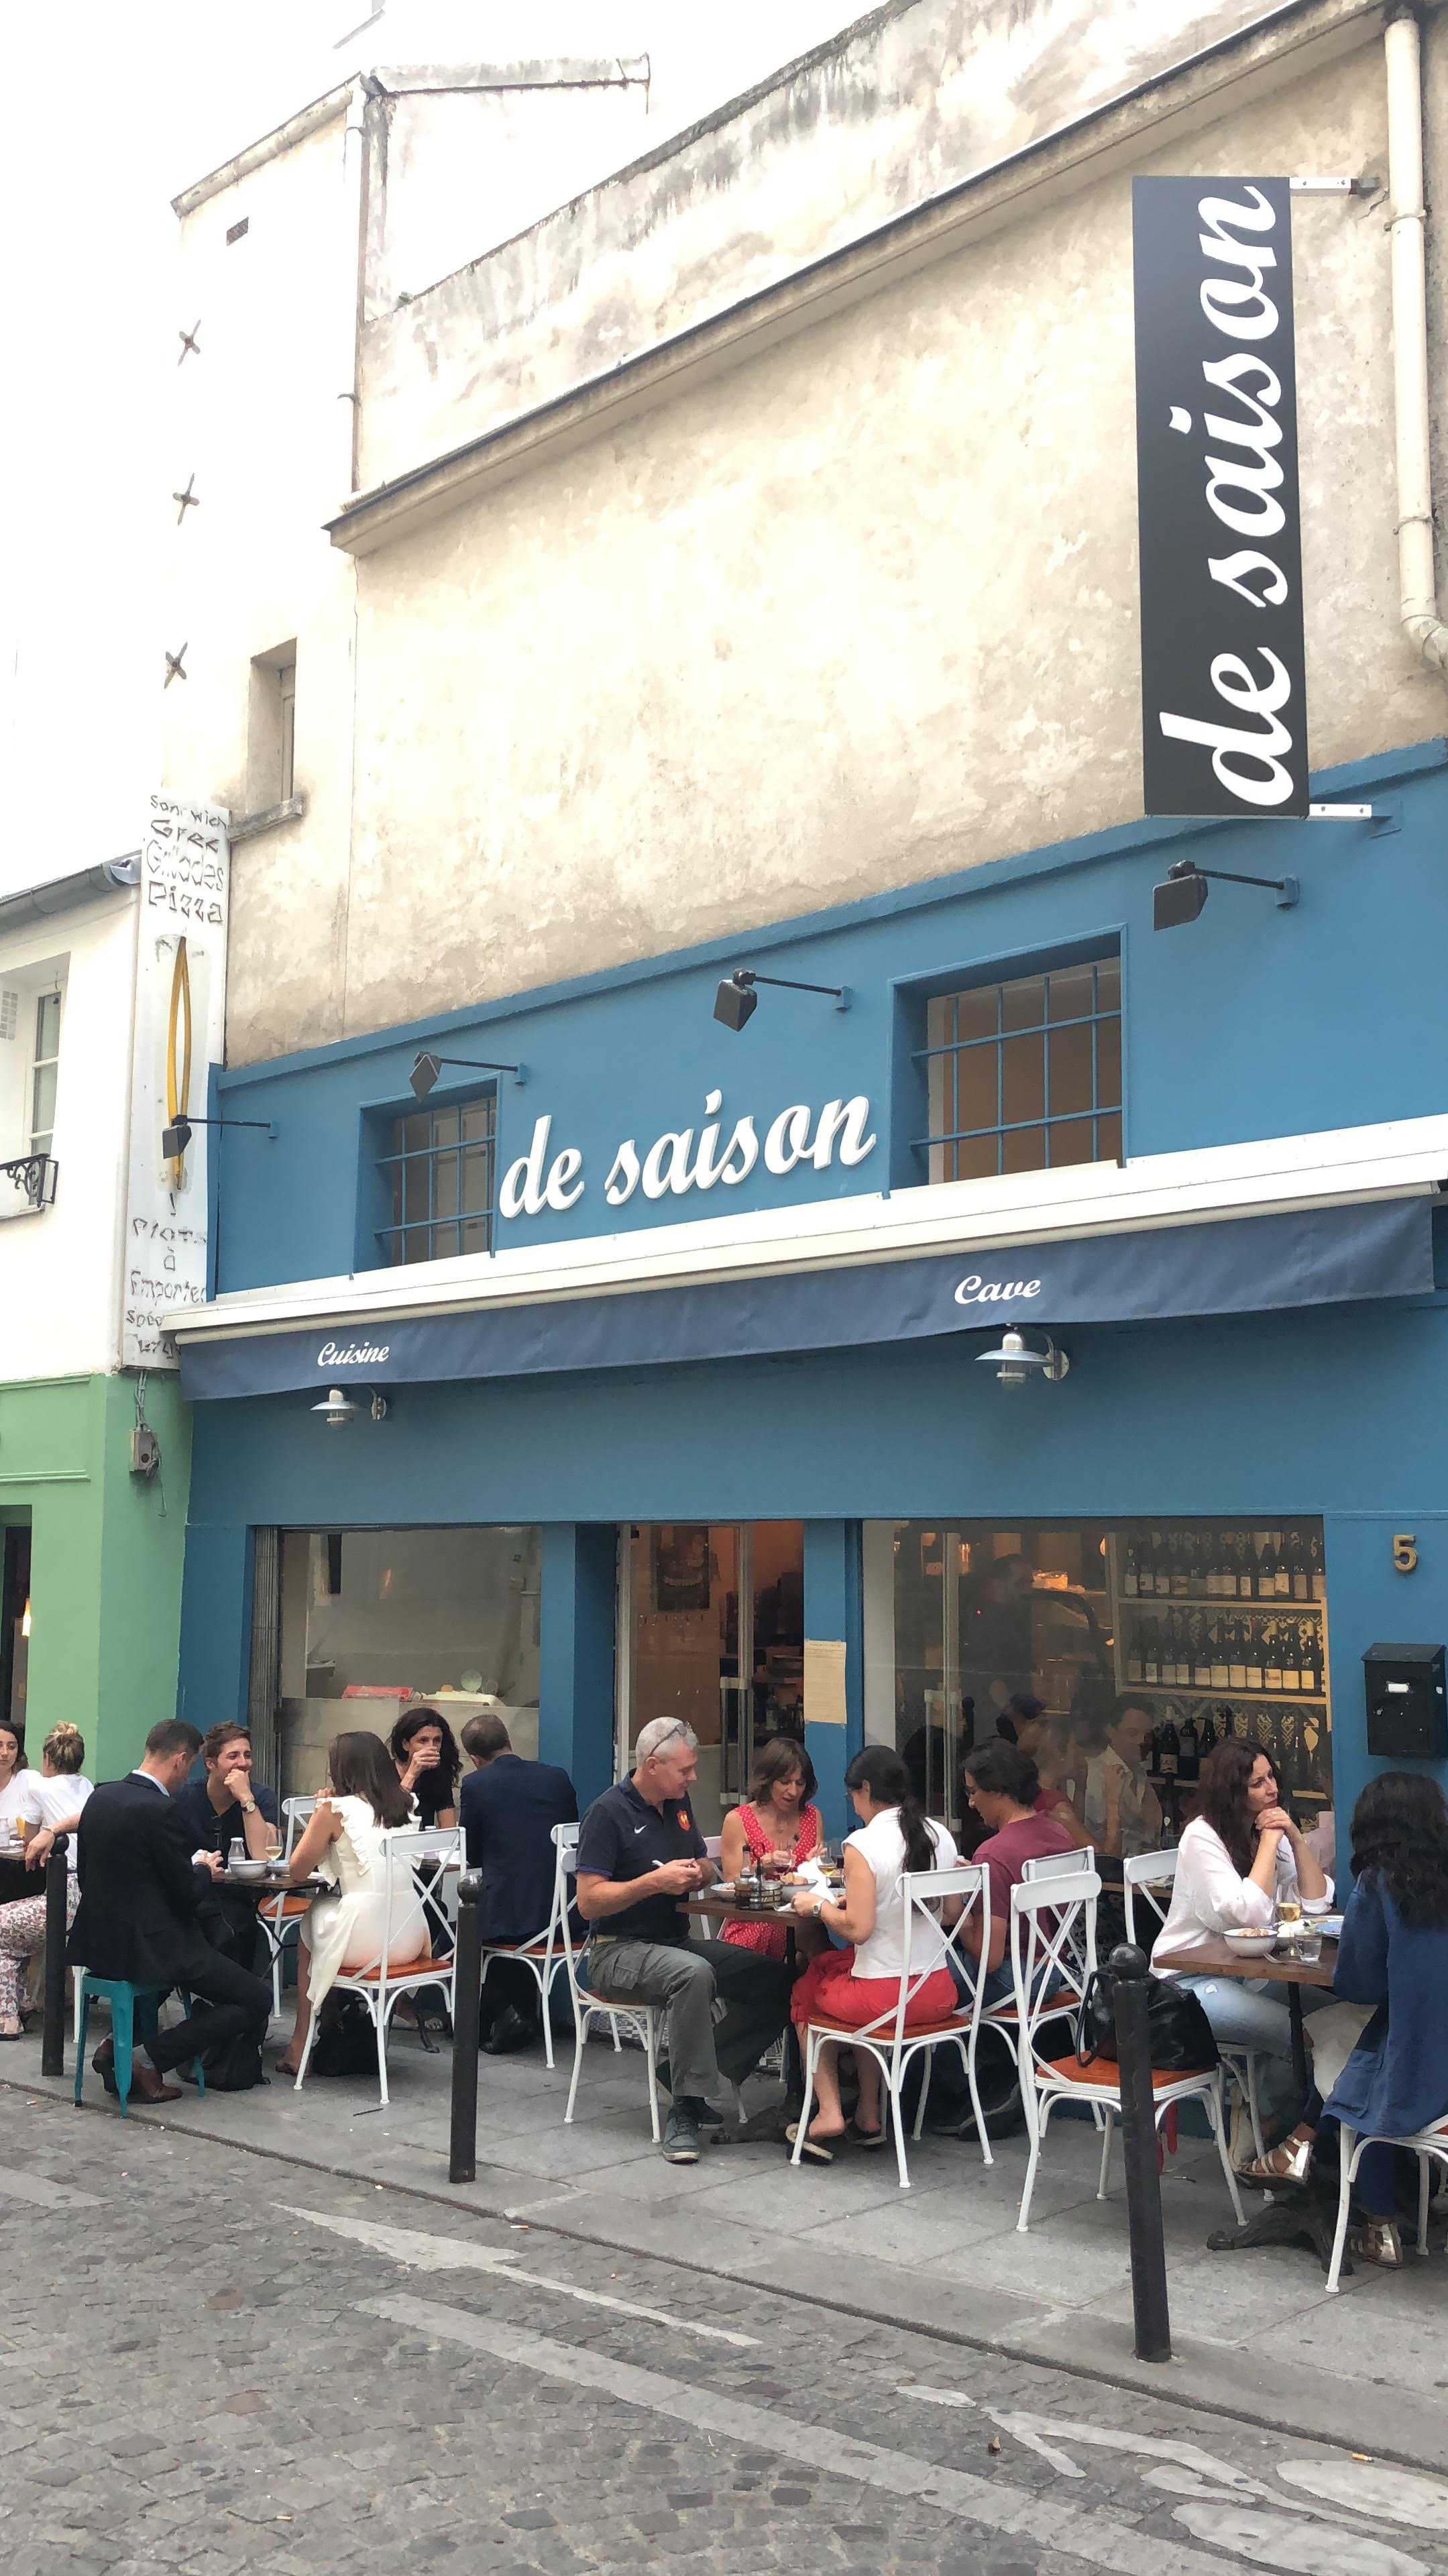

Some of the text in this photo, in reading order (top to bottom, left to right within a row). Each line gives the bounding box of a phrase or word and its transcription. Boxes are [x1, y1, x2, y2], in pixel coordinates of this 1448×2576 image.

[1160, 185, 1294, 806] de saison
[150, 794, 227, 829] Sanwich
[148, 879, 223, 924] Pizza
[499, 1089, 877, 1219] de saison
[954, 1275, 1042, 1305] Cave
[317, 1341, 390, 1367] Cuisine
[1392, 1534, 1417, 1571] 5
